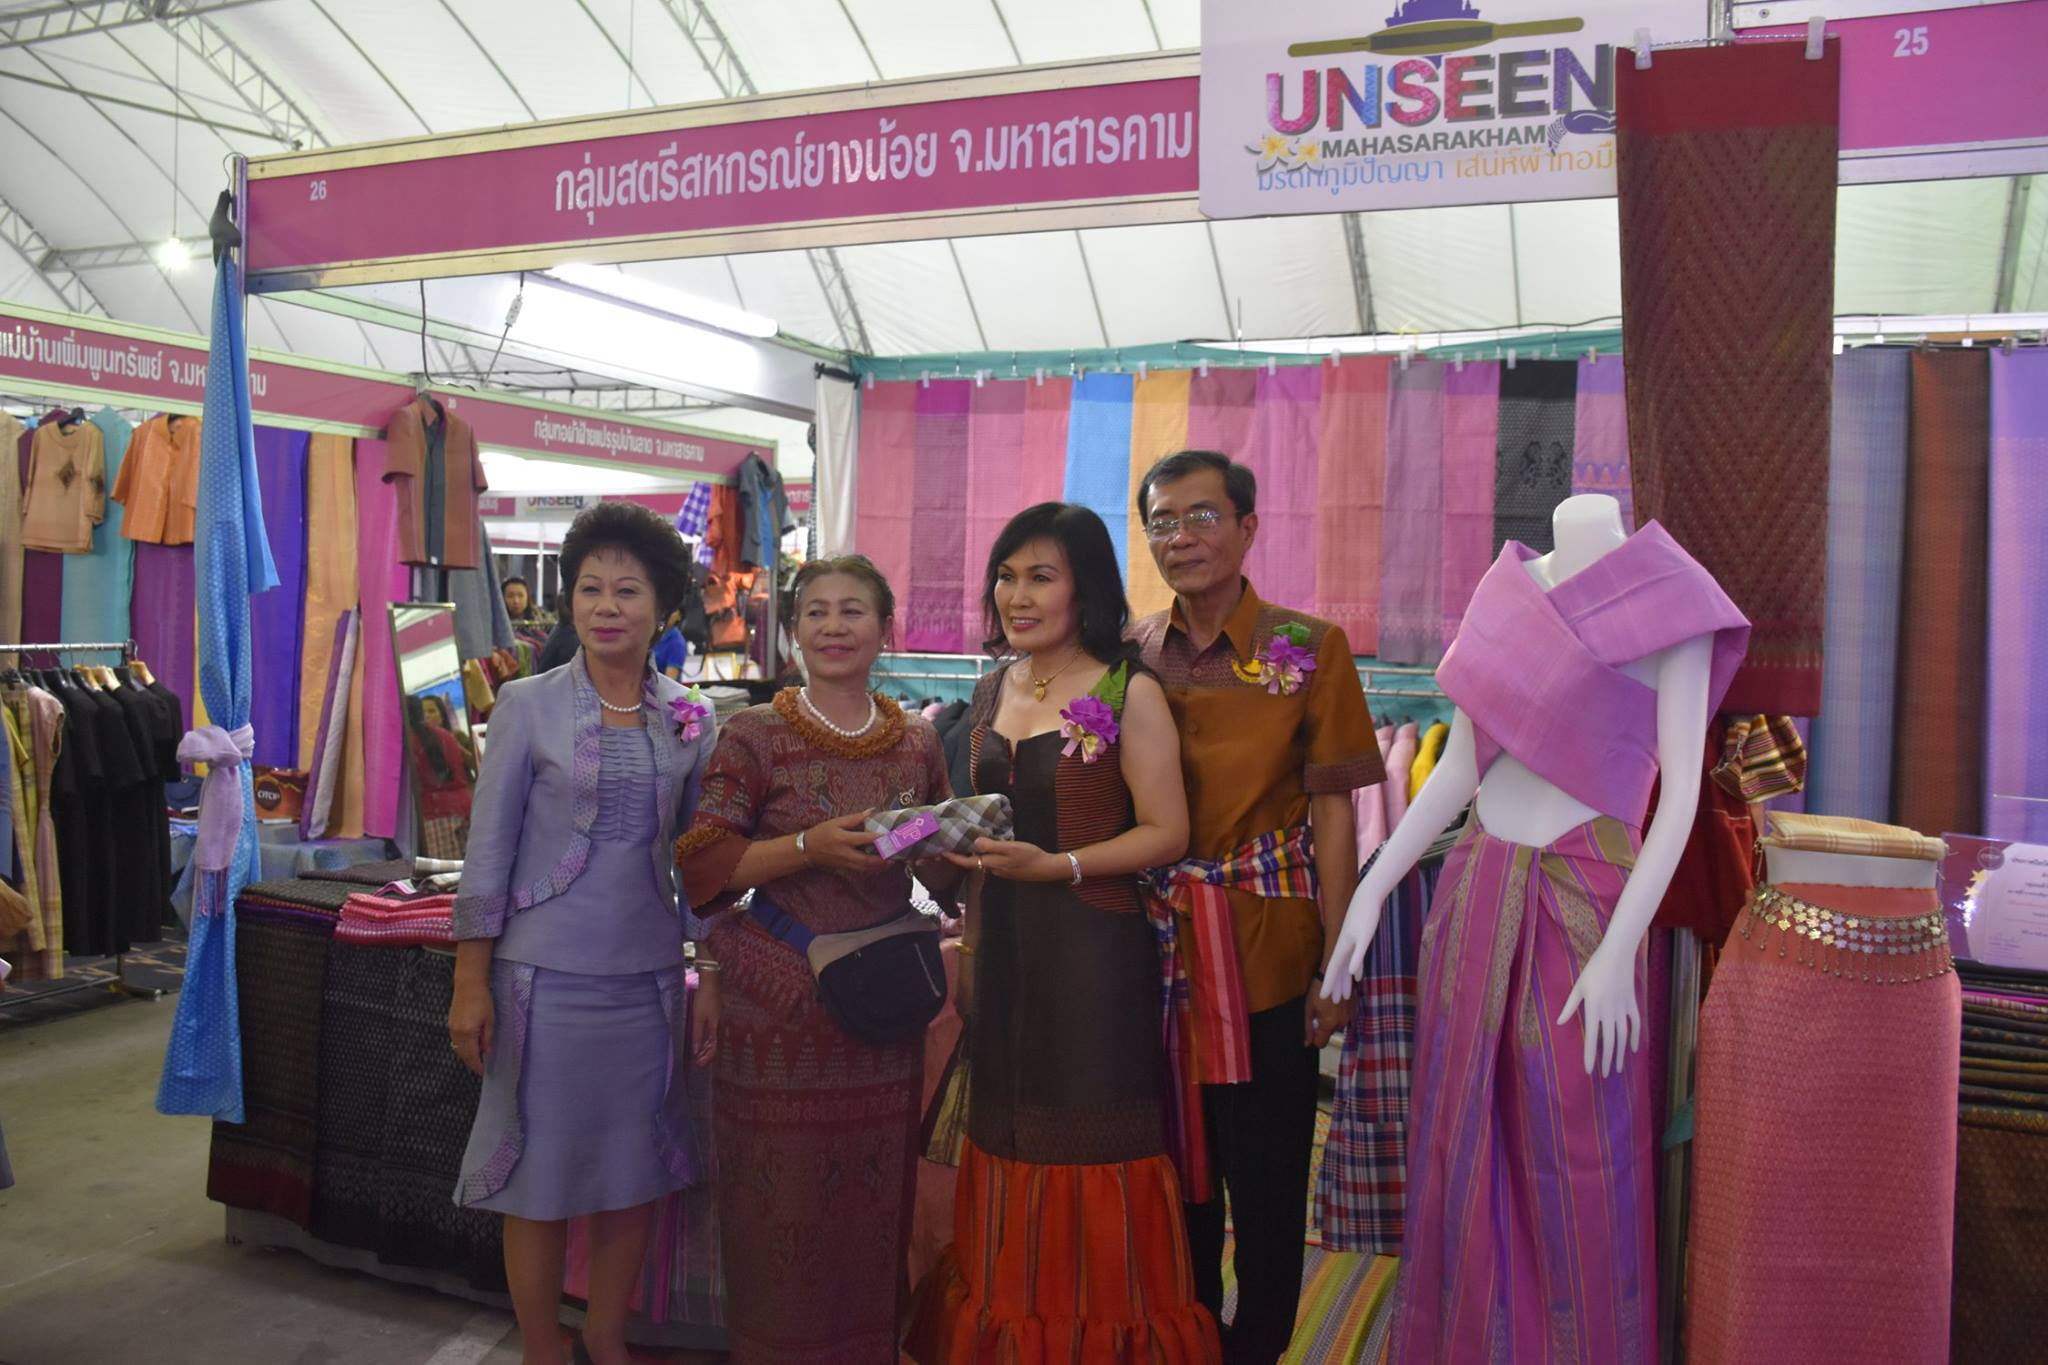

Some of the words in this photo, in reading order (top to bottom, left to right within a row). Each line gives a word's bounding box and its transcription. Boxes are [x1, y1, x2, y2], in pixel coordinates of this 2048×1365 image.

[1893, 26, 1930, 58] 25
[1266, 43, 1615, 136] UNSEEN
[1321, 124, 1546, 159] MAHASARAKHAM
[555, 117, 938, 226] กลุ่มสตรีสหกรณ์ยางน้อย
[950, 111, 1193, 174] จ.มหาสารคาม
[310, 180, 327, 201] 26
